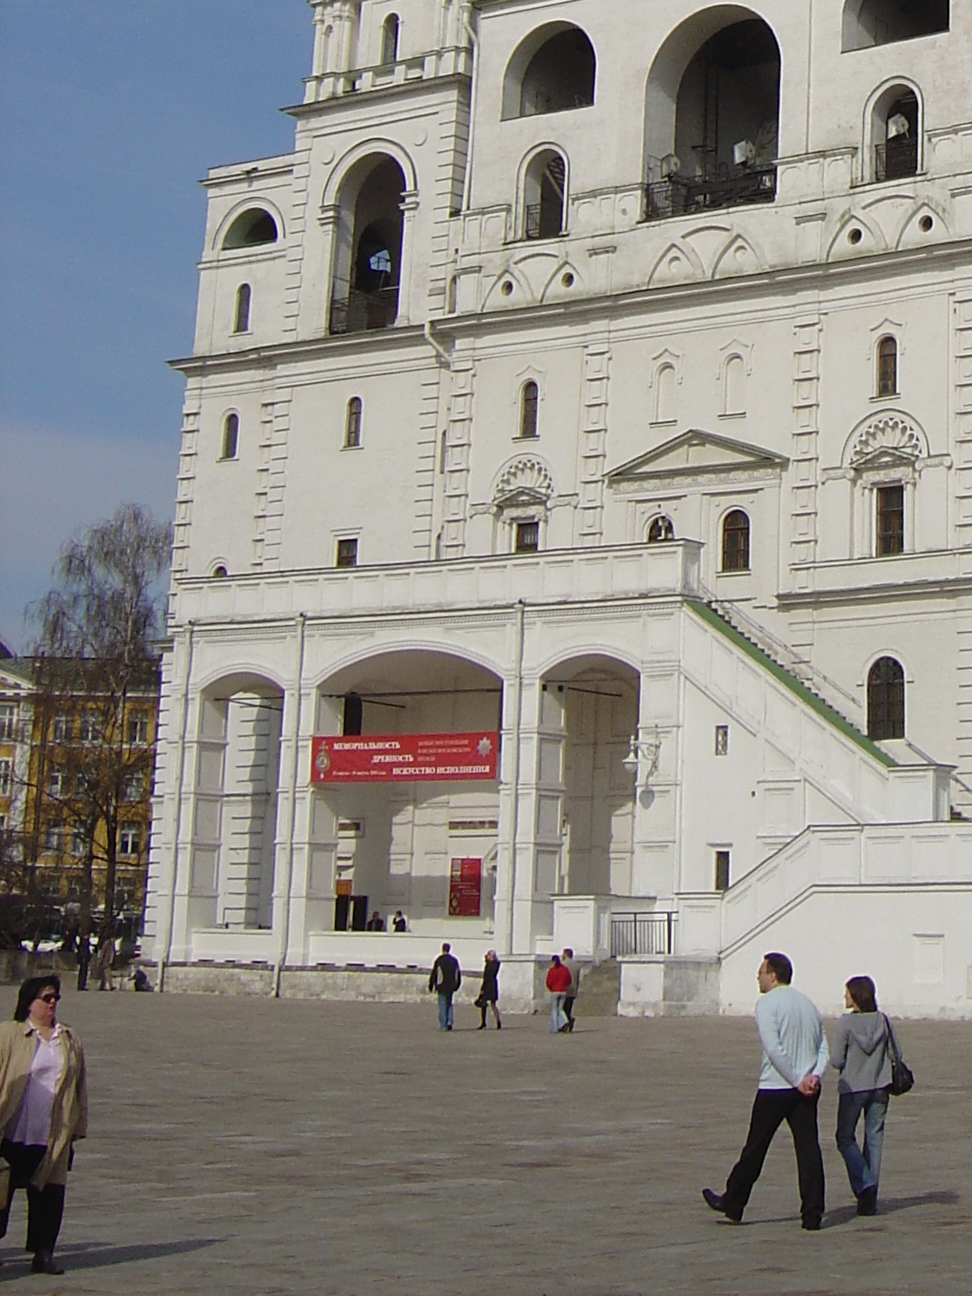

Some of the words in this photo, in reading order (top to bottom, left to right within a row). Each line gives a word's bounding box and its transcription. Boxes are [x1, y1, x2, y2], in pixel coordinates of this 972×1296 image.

[371, 754, 414, 764] ДРЕВНОСТЬ
[392, 766, 436, 776] ИСКУССТВО
[436, 765, 490, 775] ИСПОЛНЕНИЯ
